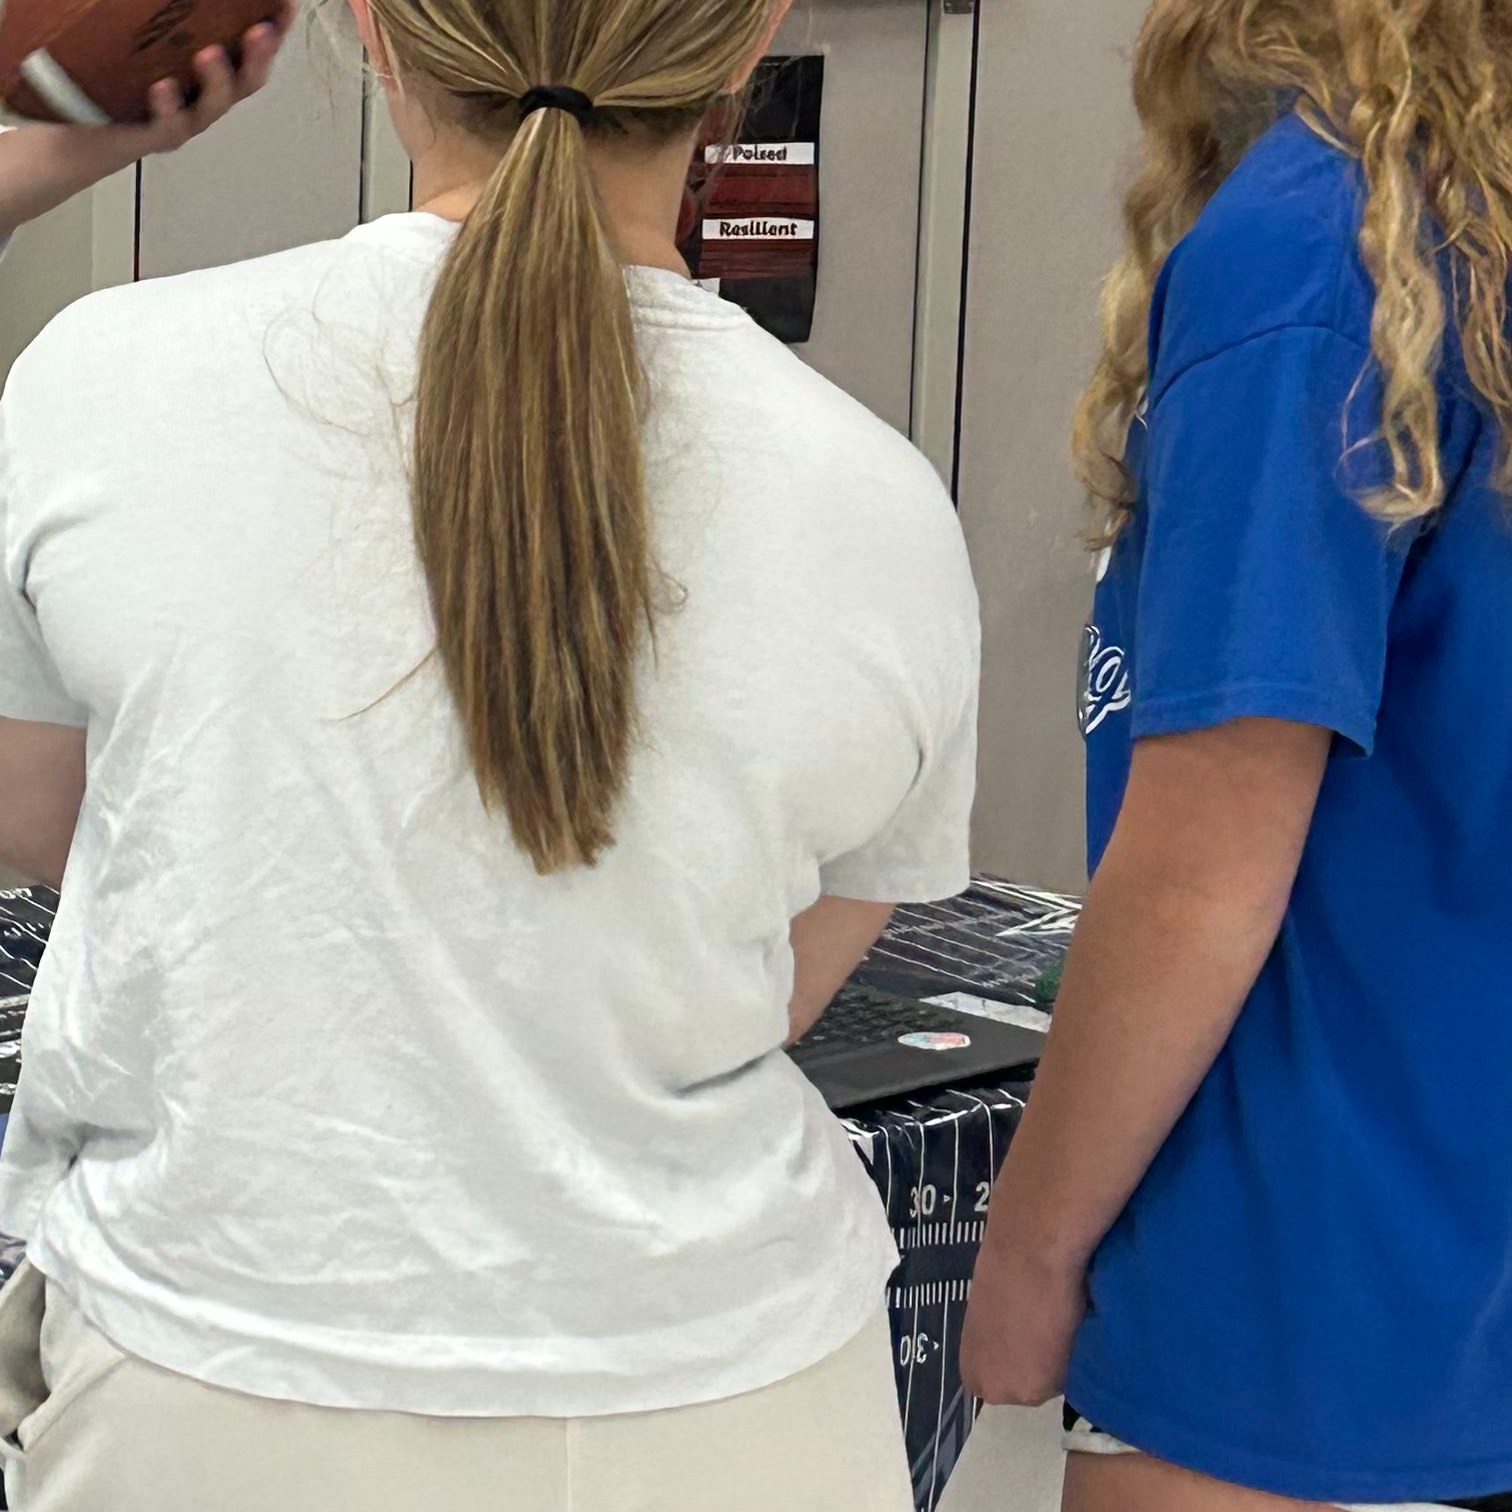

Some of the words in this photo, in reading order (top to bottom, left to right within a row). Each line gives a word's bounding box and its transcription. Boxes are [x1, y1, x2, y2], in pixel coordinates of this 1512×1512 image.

[732, 144, 788, 162] Poised
[719, 220, 798, 237] Resilient
[908, 1183, 937, 1219] 30
